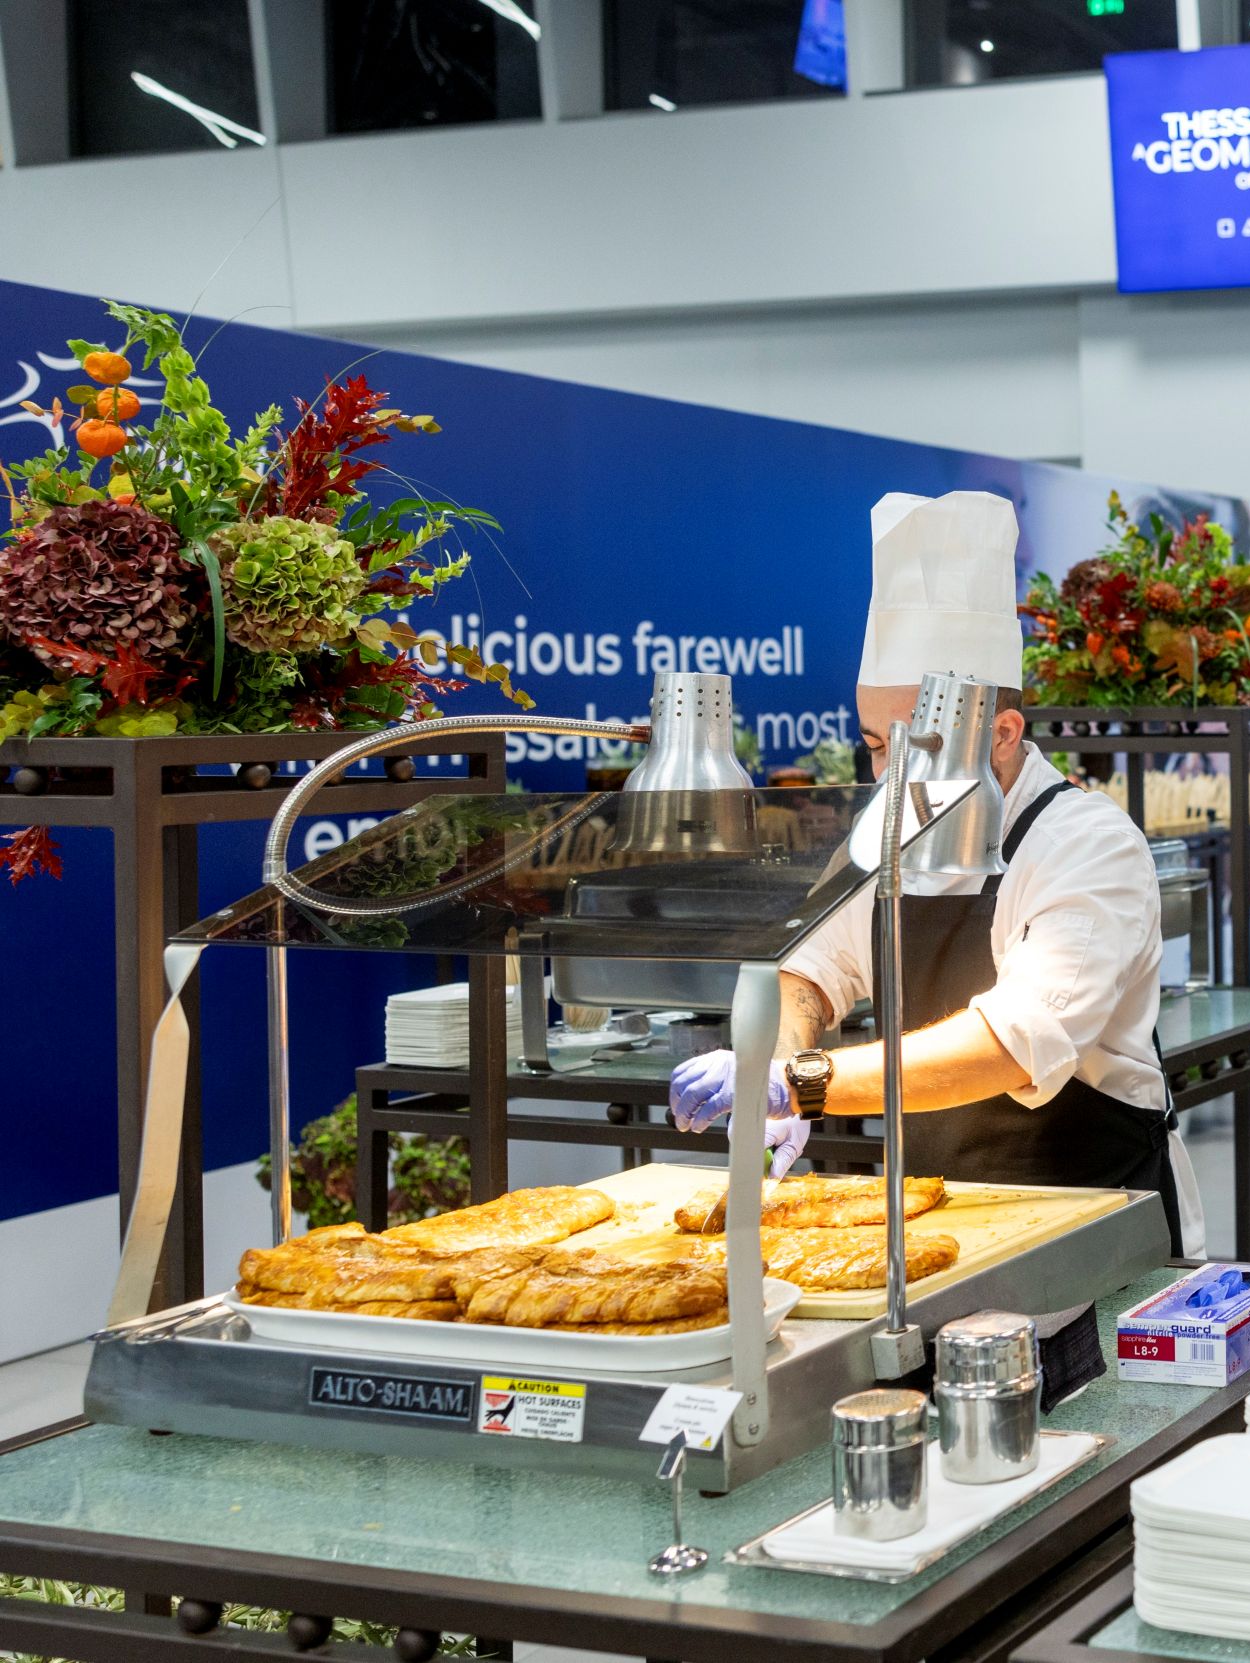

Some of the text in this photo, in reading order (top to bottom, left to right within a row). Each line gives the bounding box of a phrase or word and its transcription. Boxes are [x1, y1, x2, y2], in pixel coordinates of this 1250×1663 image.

[632, 621, 804, 676] farewell
[757, 704, 851, 750] most
[517, 1383, 560, 1393] CAUTION
[518, 1395, 582, 1409] HOT SURFACES
